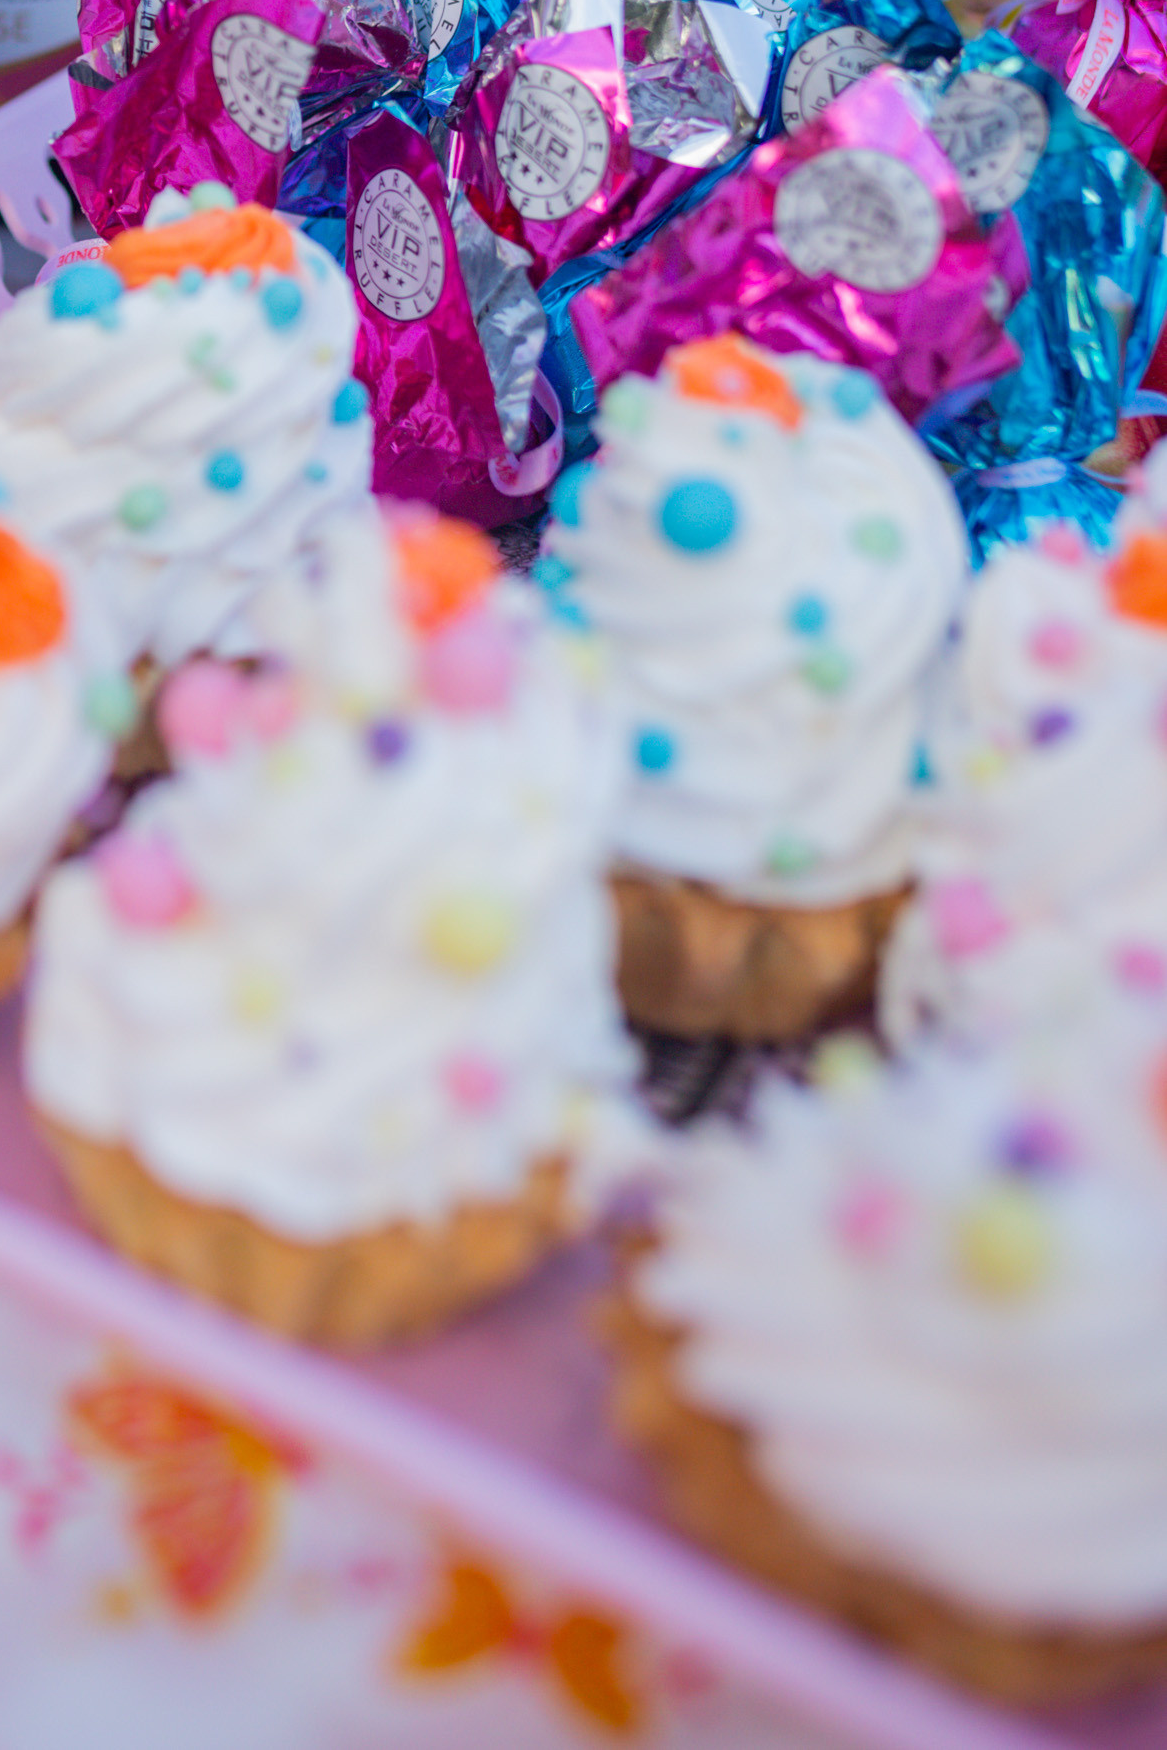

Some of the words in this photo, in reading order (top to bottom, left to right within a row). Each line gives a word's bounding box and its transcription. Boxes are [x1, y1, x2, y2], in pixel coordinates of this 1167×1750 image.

[1075, 33, 1115, 100] MONDE
[363, 171, 441, 270] CARAMEL
[369, 233, 419, 275] DESERT
[353, 222, 435, 316] TRUFFLE
